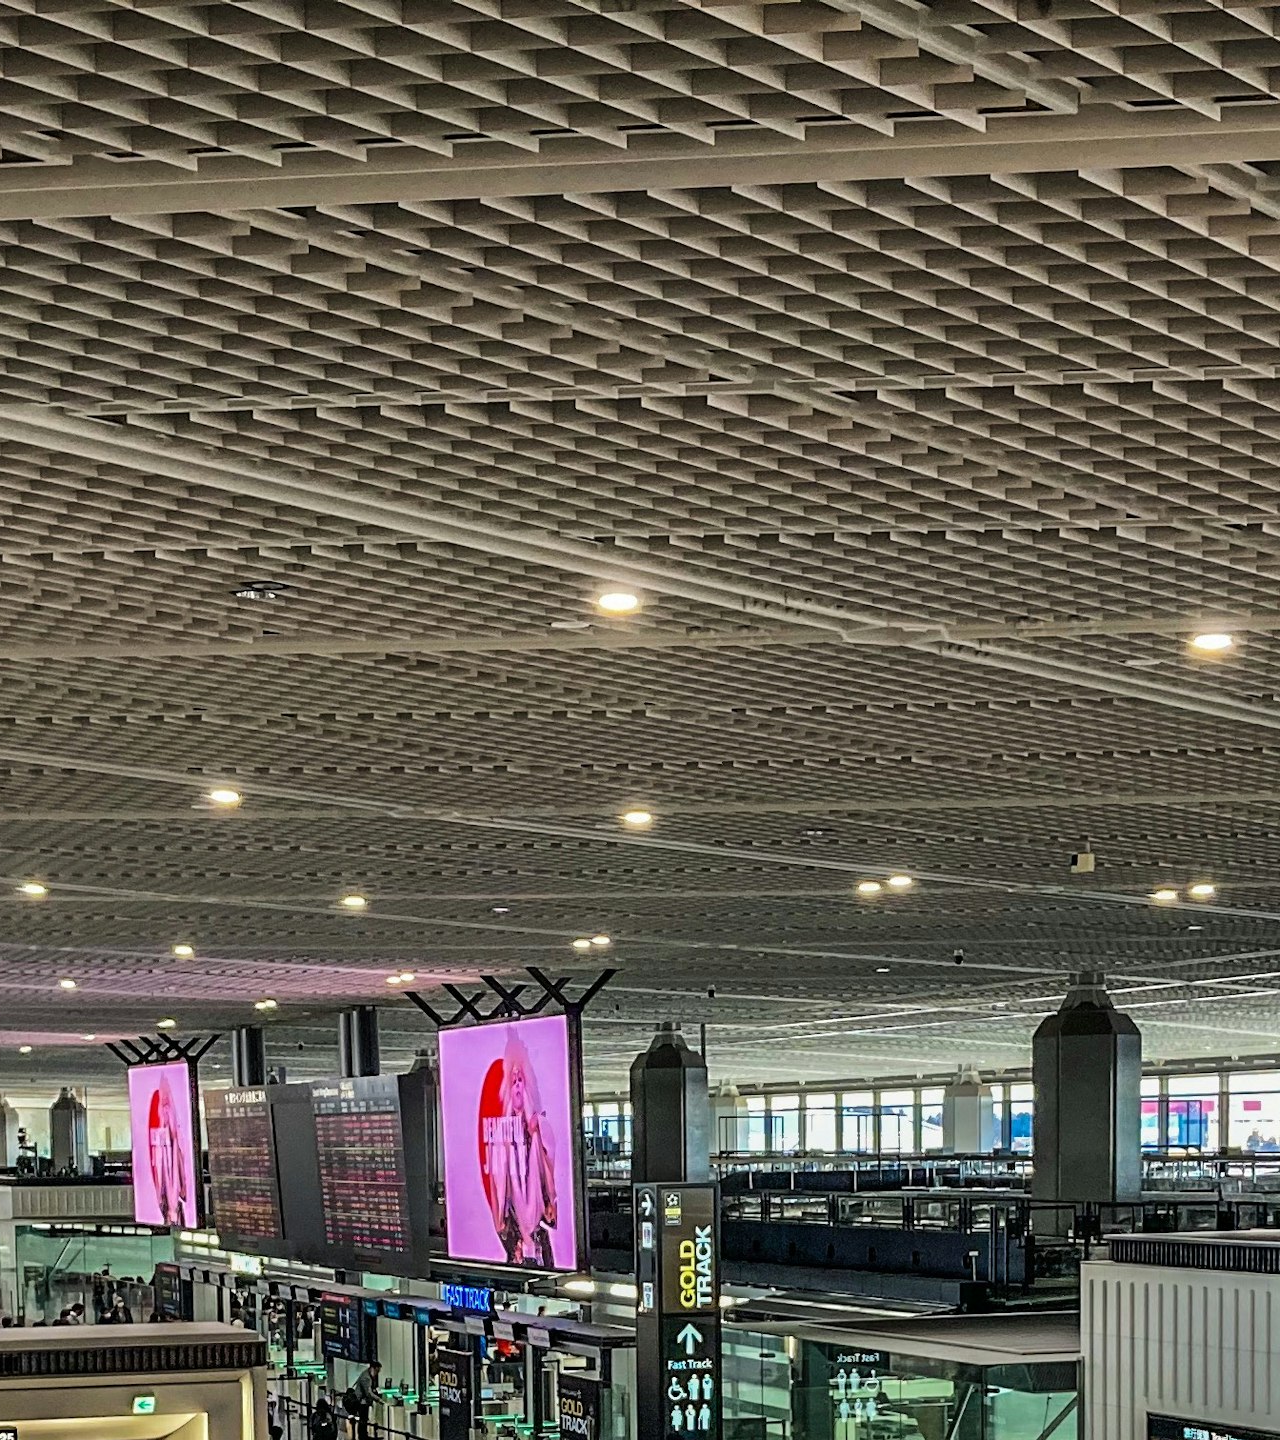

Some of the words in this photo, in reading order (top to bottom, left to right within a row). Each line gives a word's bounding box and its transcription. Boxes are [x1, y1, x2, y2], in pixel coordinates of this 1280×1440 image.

[680, 1239, 696, 1308] GOLD
[695, 1224, 713, 1309] TRACK
[445, 1284, 463, 1307] FAST
[464, 1287, 490, 1312] TRACK
[668, 1360, 687, 1370] Fast
[688, 1358, 712, 1369] Track
[439, 1371, 458, 1387] GOLD
[439, 1386, 462, 1404] TRACK
[561, 1399, 583, 1417] GOLD
[561, 1414, 588, 1435] TRACK
